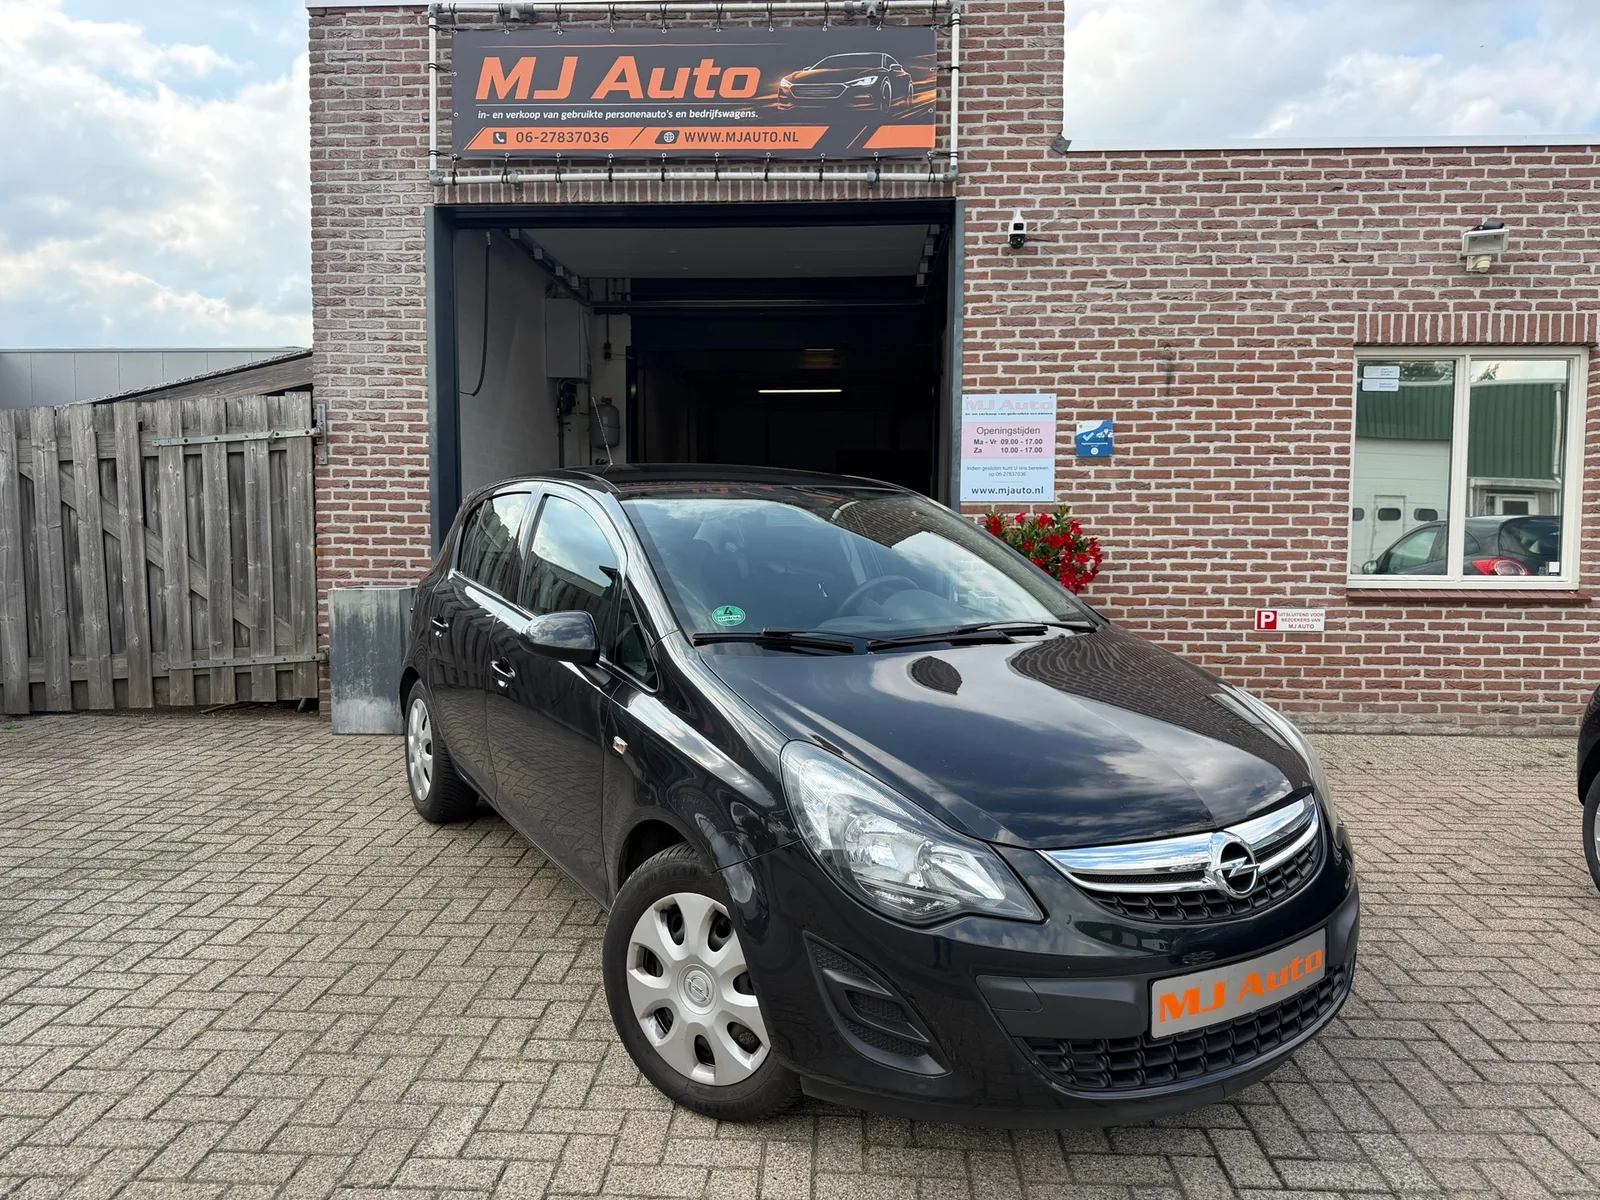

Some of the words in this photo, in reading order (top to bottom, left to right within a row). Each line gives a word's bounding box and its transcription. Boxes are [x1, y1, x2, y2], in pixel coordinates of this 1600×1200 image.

[475, 56, 578, 100] MJ
[590, 55, 761, 100] Auto
[477, 110, 490, 119] in-
[505, 110, 541, 120] verkoop
[543, 111, 559, 119] van
[560, 109, 604, 120] gebruikte
[605, 109, 674, 120] personenauto's
[675, 111, 687, 119] en
[689, 109, 759, 120] bedrijfswagens.
[515, 131, 609, 143] 06-27837036
[684, 131, 799, 143] WWW.MJAUTO.NL
[966, 400, 995, 410] MJ
[999, 400, 1053, 410] Auto
[976, 426, 1041, 436] Openingstijden
[971, 486, 1044, 496] www.mjauto.nl
[723, 607, 733, 615] 4
[1261, 611, 1275, 628] P
[1159, 981, 1228, 1024] MJ
[1235, 949, 1323, 1004] Auto
